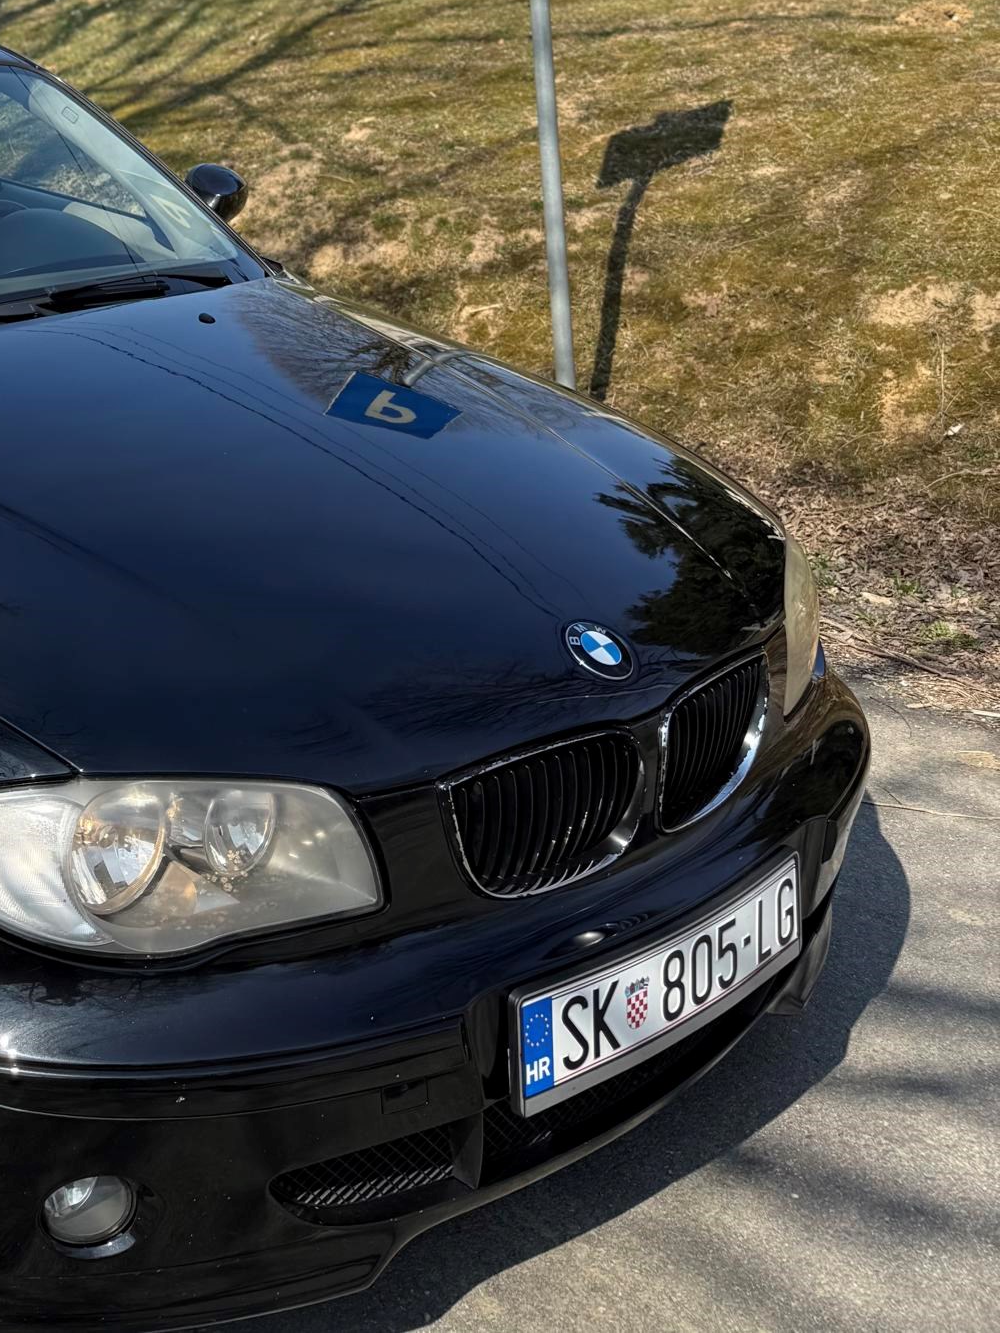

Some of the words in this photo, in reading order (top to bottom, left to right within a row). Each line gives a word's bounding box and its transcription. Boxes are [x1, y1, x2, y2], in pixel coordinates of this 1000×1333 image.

[568, 623, 607, 646] BMW
[561, 979, 621, 1071] SK
[661, 878, 794, 1021] 805-LG
[525, 1056, 551, 1085] HR
